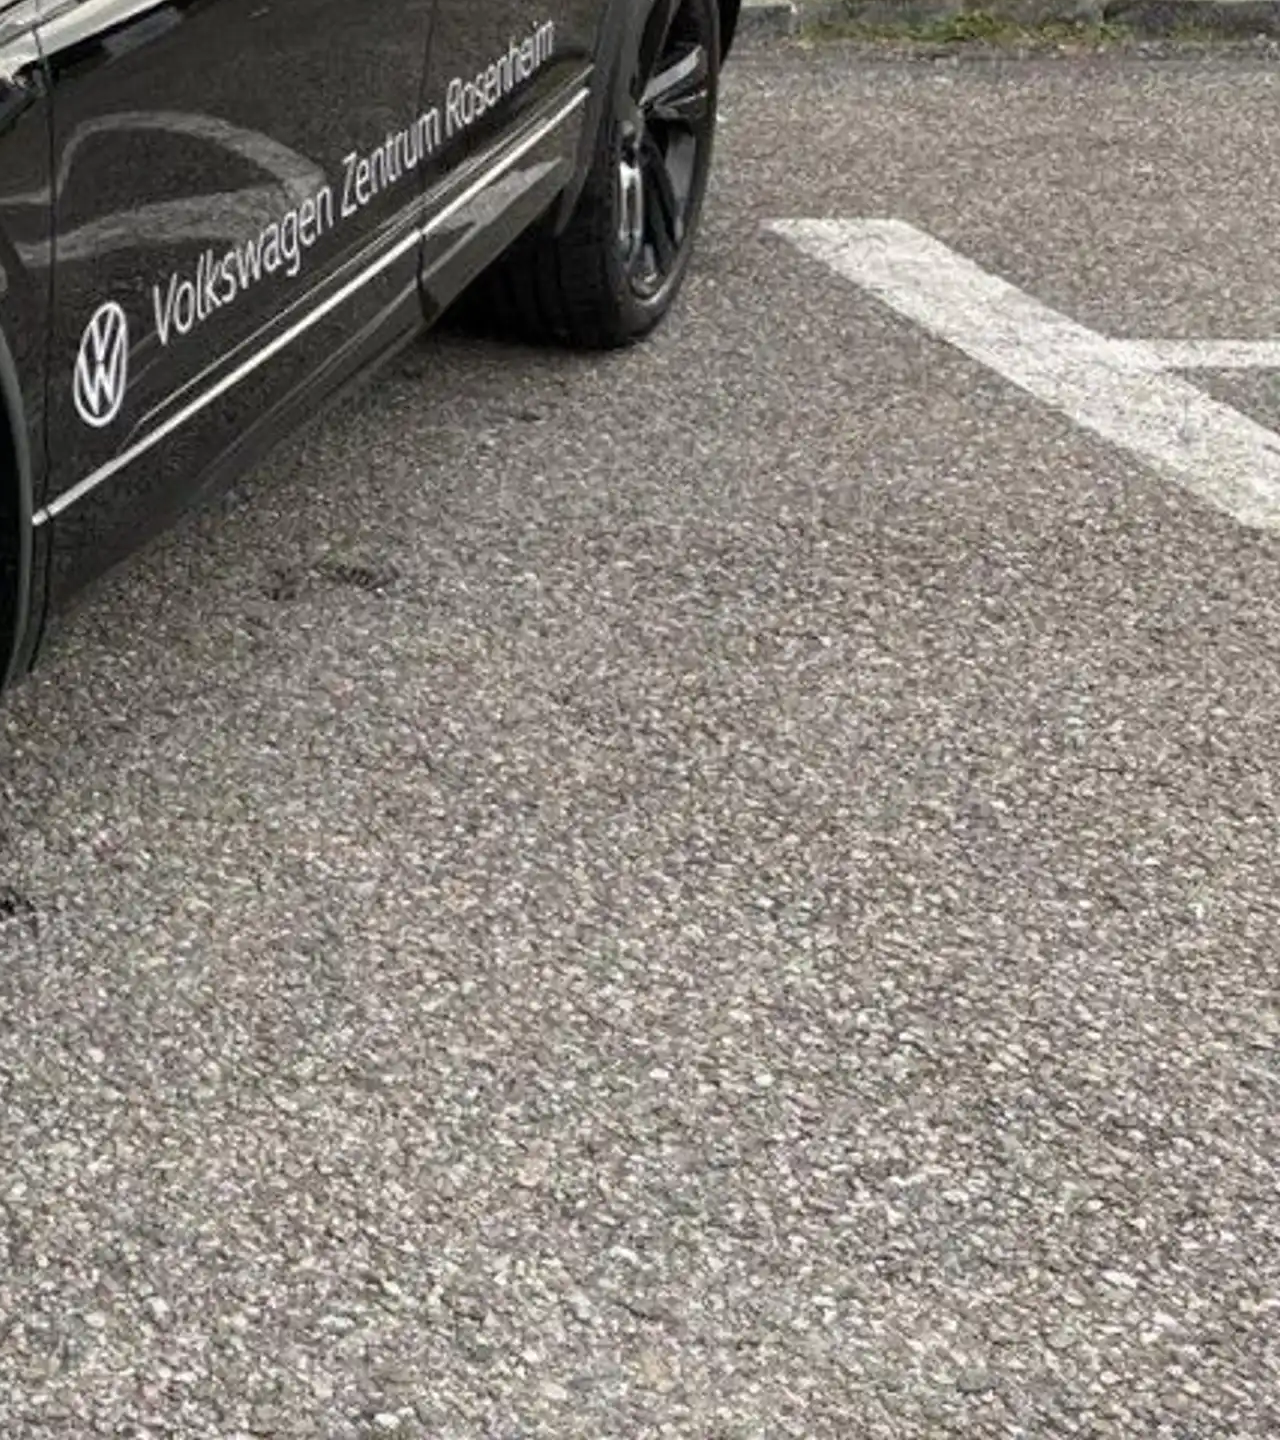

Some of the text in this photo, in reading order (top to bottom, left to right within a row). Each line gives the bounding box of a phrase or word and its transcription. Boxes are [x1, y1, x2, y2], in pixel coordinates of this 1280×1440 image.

[152, 18, 556, 347] Volkswagen Zentrum Rosenheim
